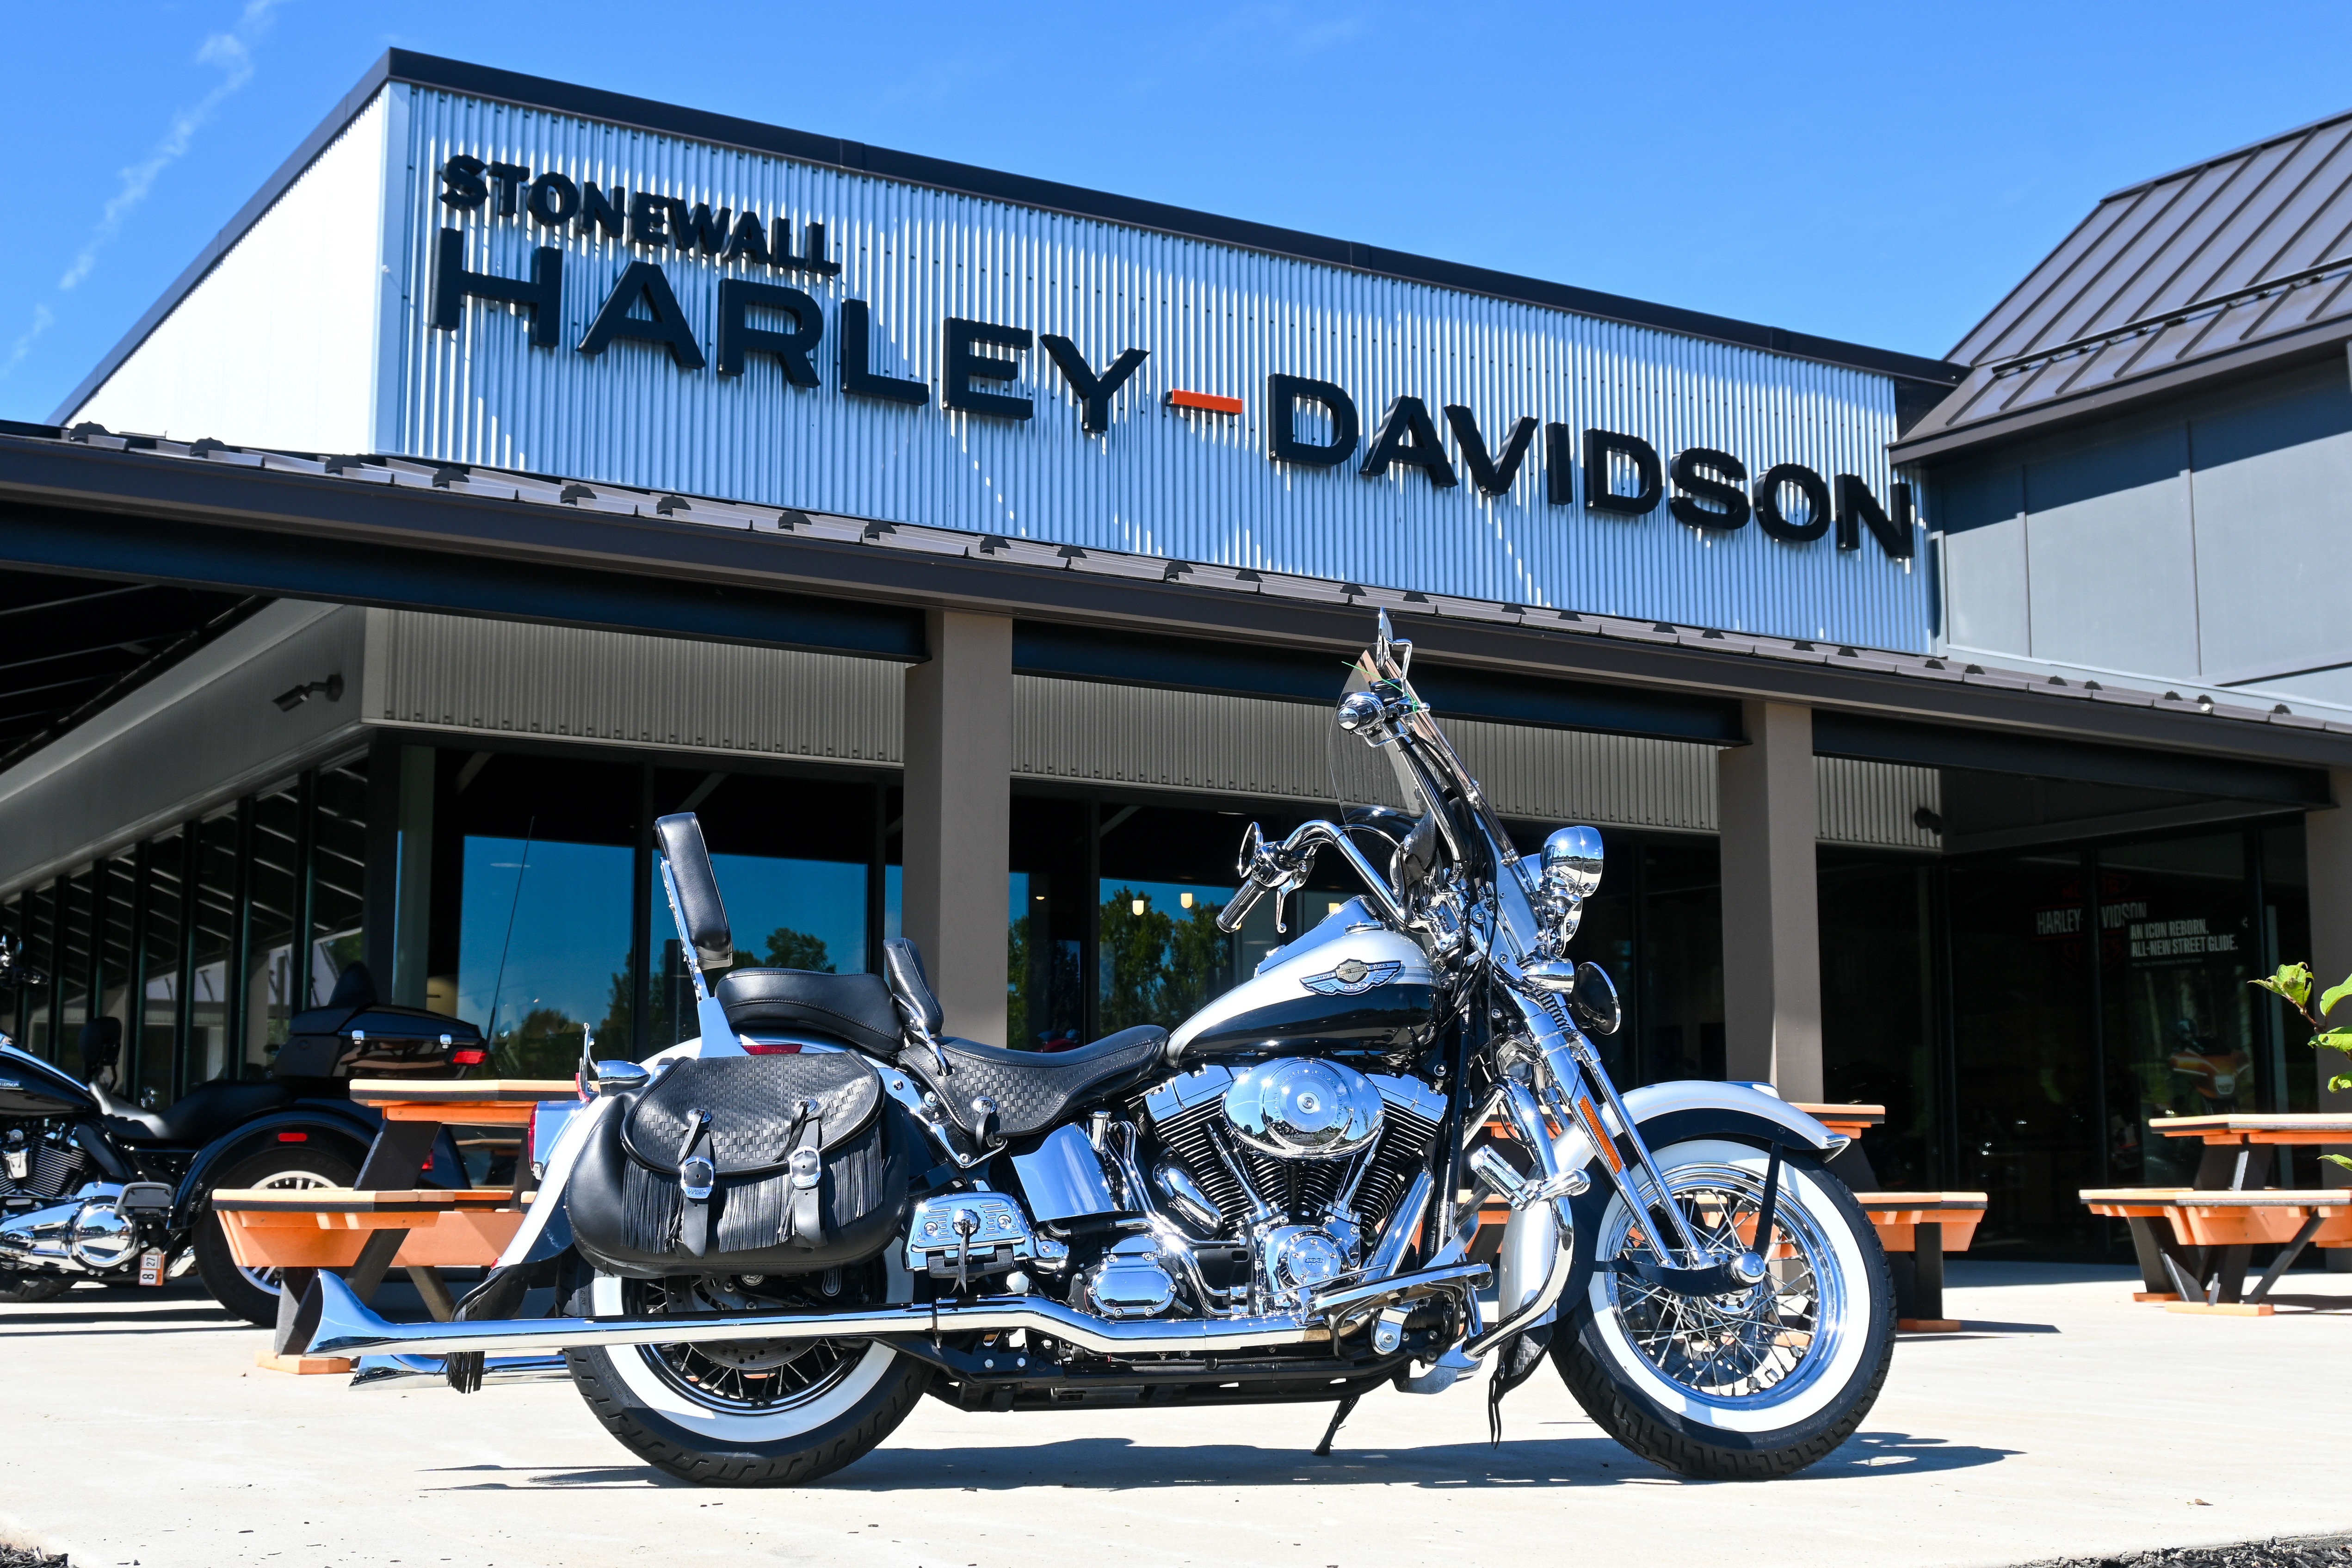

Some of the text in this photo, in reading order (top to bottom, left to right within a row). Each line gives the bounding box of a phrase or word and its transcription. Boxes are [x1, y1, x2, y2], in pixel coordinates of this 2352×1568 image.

[438, 154, 841, 277] STONEWALL
[2131, 919, 2210, 940] AN ICON REBORN.
[2131, 933, 2238, 957] ALL-NEW STREET GLIDE.
[146, 1257, 155, 1267] 27
